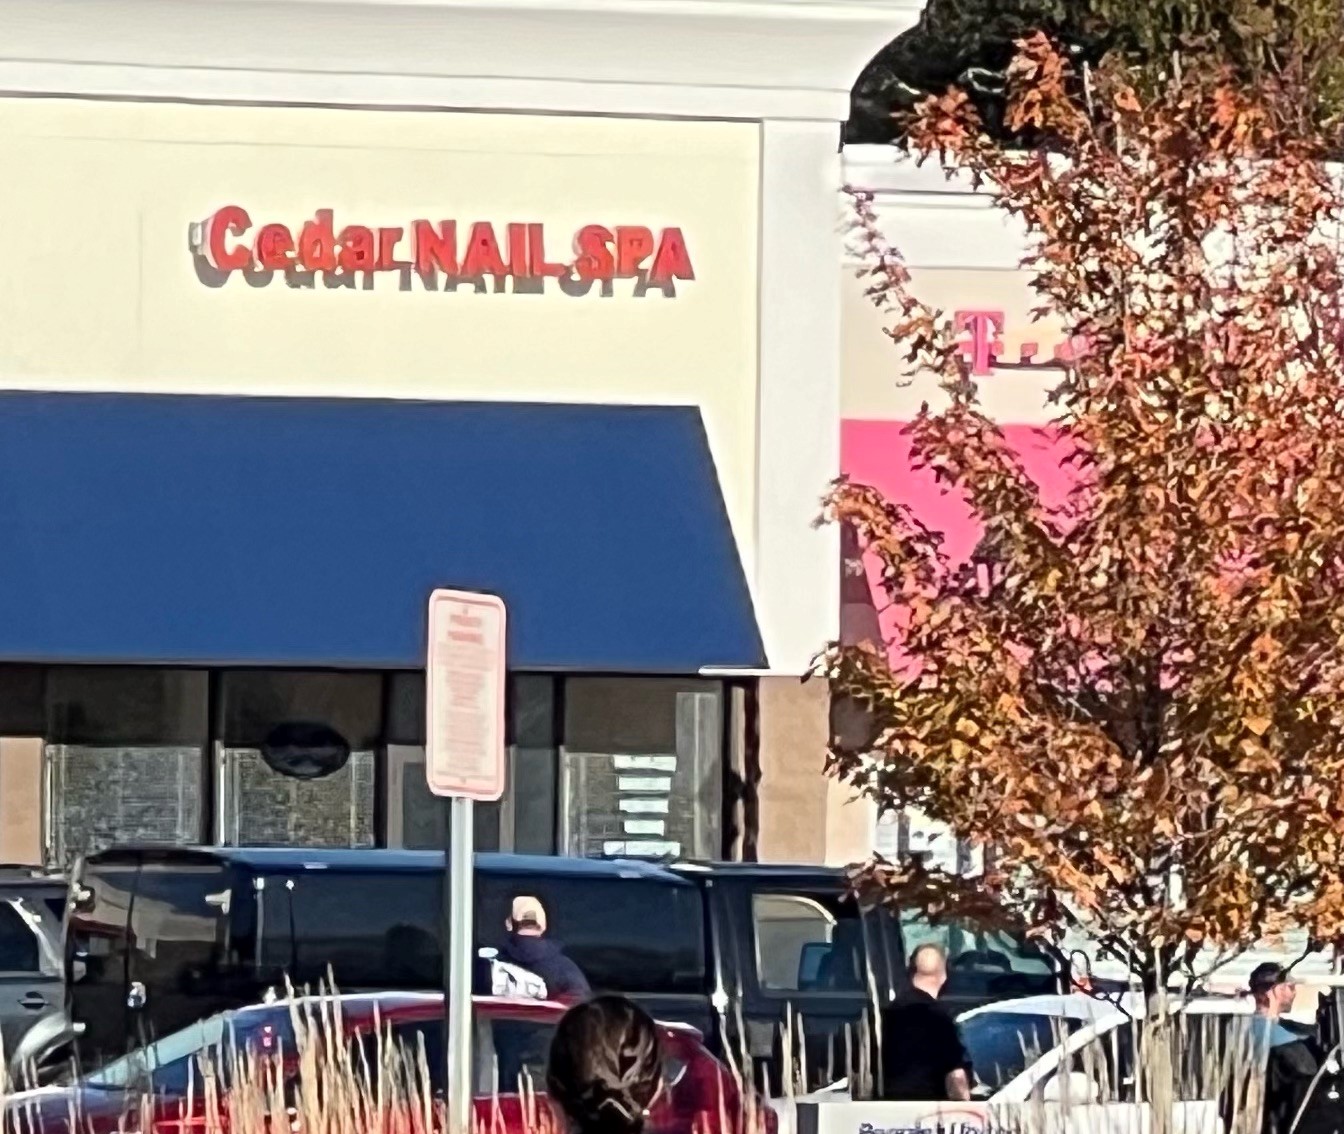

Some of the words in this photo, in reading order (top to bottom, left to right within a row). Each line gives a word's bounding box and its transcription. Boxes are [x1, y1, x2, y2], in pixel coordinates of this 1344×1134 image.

[205, 205, 404, 274] Cedar
[412, 219, 566, 278] NAIL
[571, 224, 696, 283] SPA
